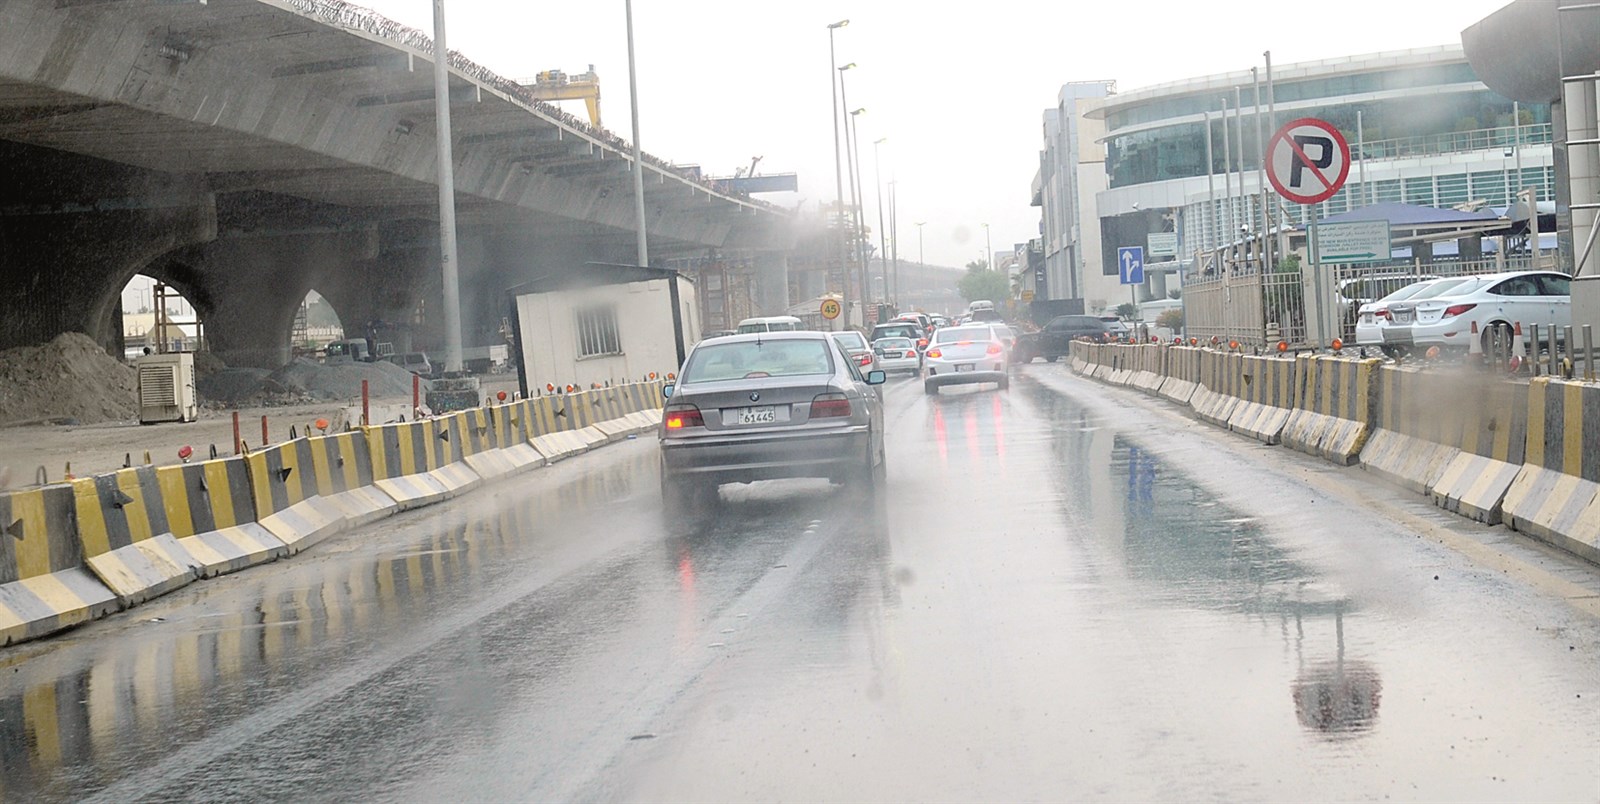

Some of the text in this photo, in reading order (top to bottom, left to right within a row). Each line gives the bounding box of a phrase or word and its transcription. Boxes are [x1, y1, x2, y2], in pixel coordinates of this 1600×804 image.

[1290, 135, 1333, 188] P
[824, 304, 837, 314] 45
[744, 412, 774, 423] 61445
